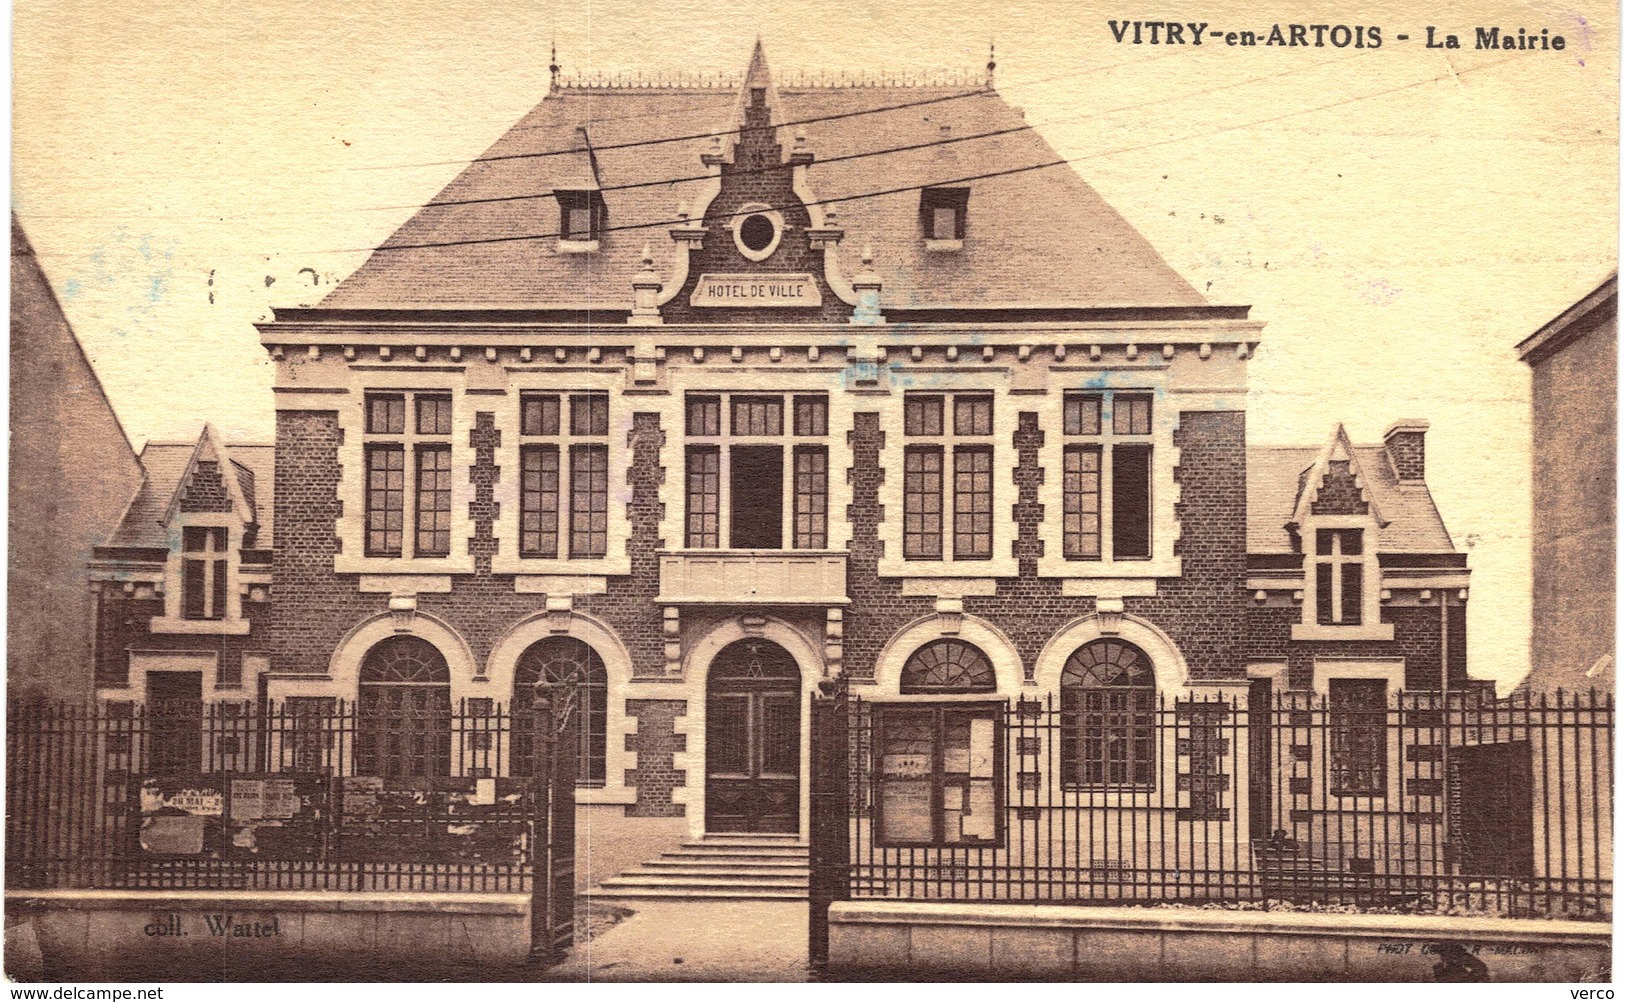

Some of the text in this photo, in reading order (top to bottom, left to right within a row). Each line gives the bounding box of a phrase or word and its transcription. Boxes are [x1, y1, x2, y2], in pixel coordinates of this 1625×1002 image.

[708, 285, 804, 298] HOTEL DE VILLE
